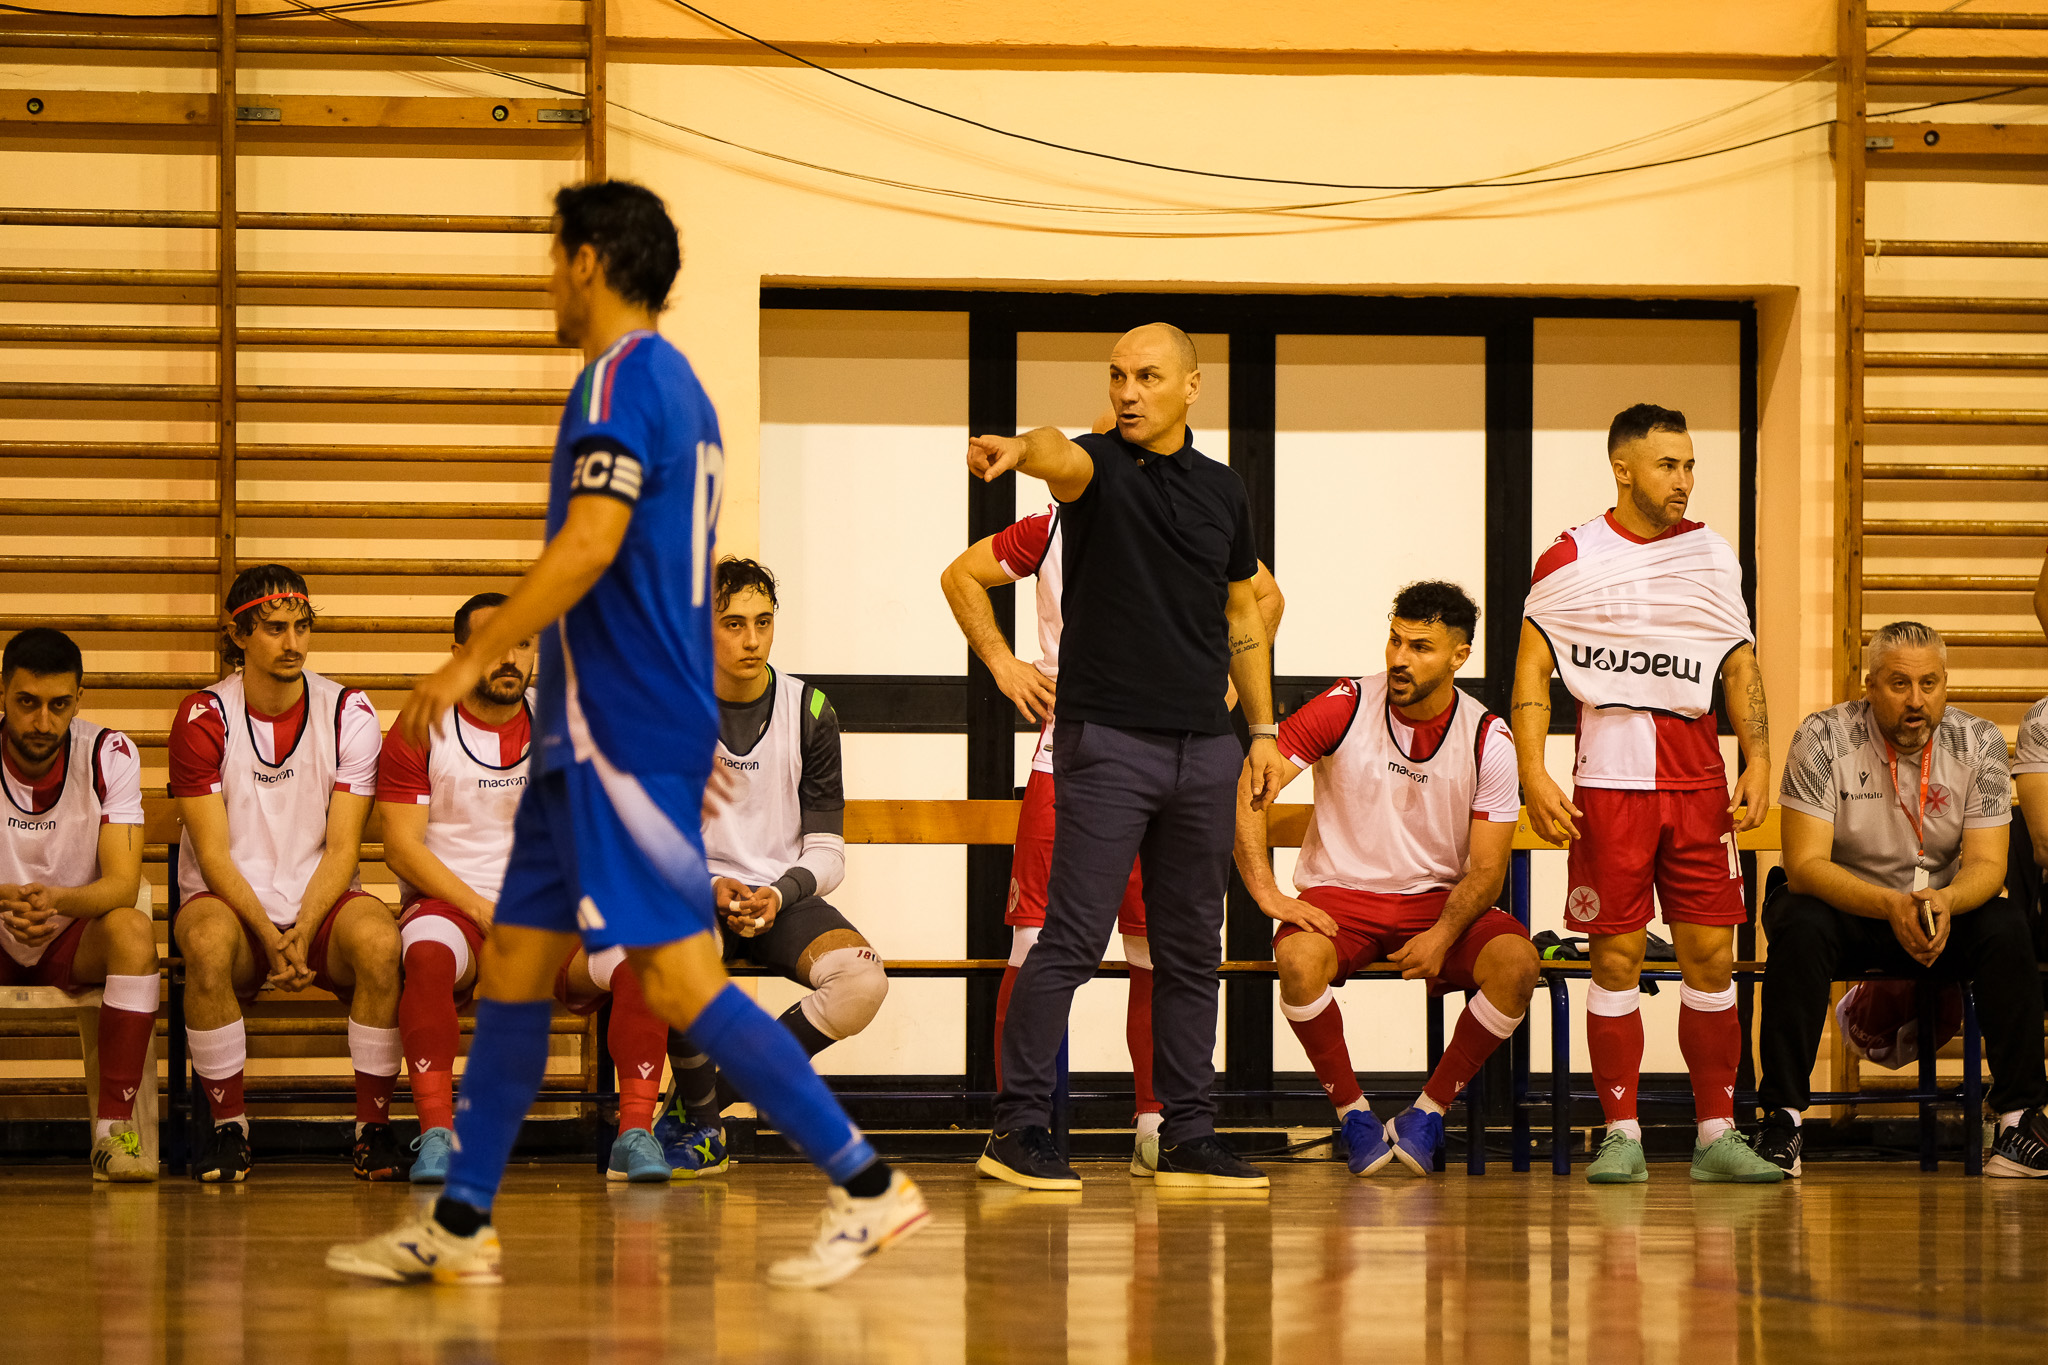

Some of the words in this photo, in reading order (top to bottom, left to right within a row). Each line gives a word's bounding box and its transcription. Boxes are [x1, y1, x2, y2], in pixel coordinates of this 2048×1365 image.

[1571, 643, 1702, 684] macron
[478, 776, 528, 788] macron
[7, 817, 56, 831] macron
